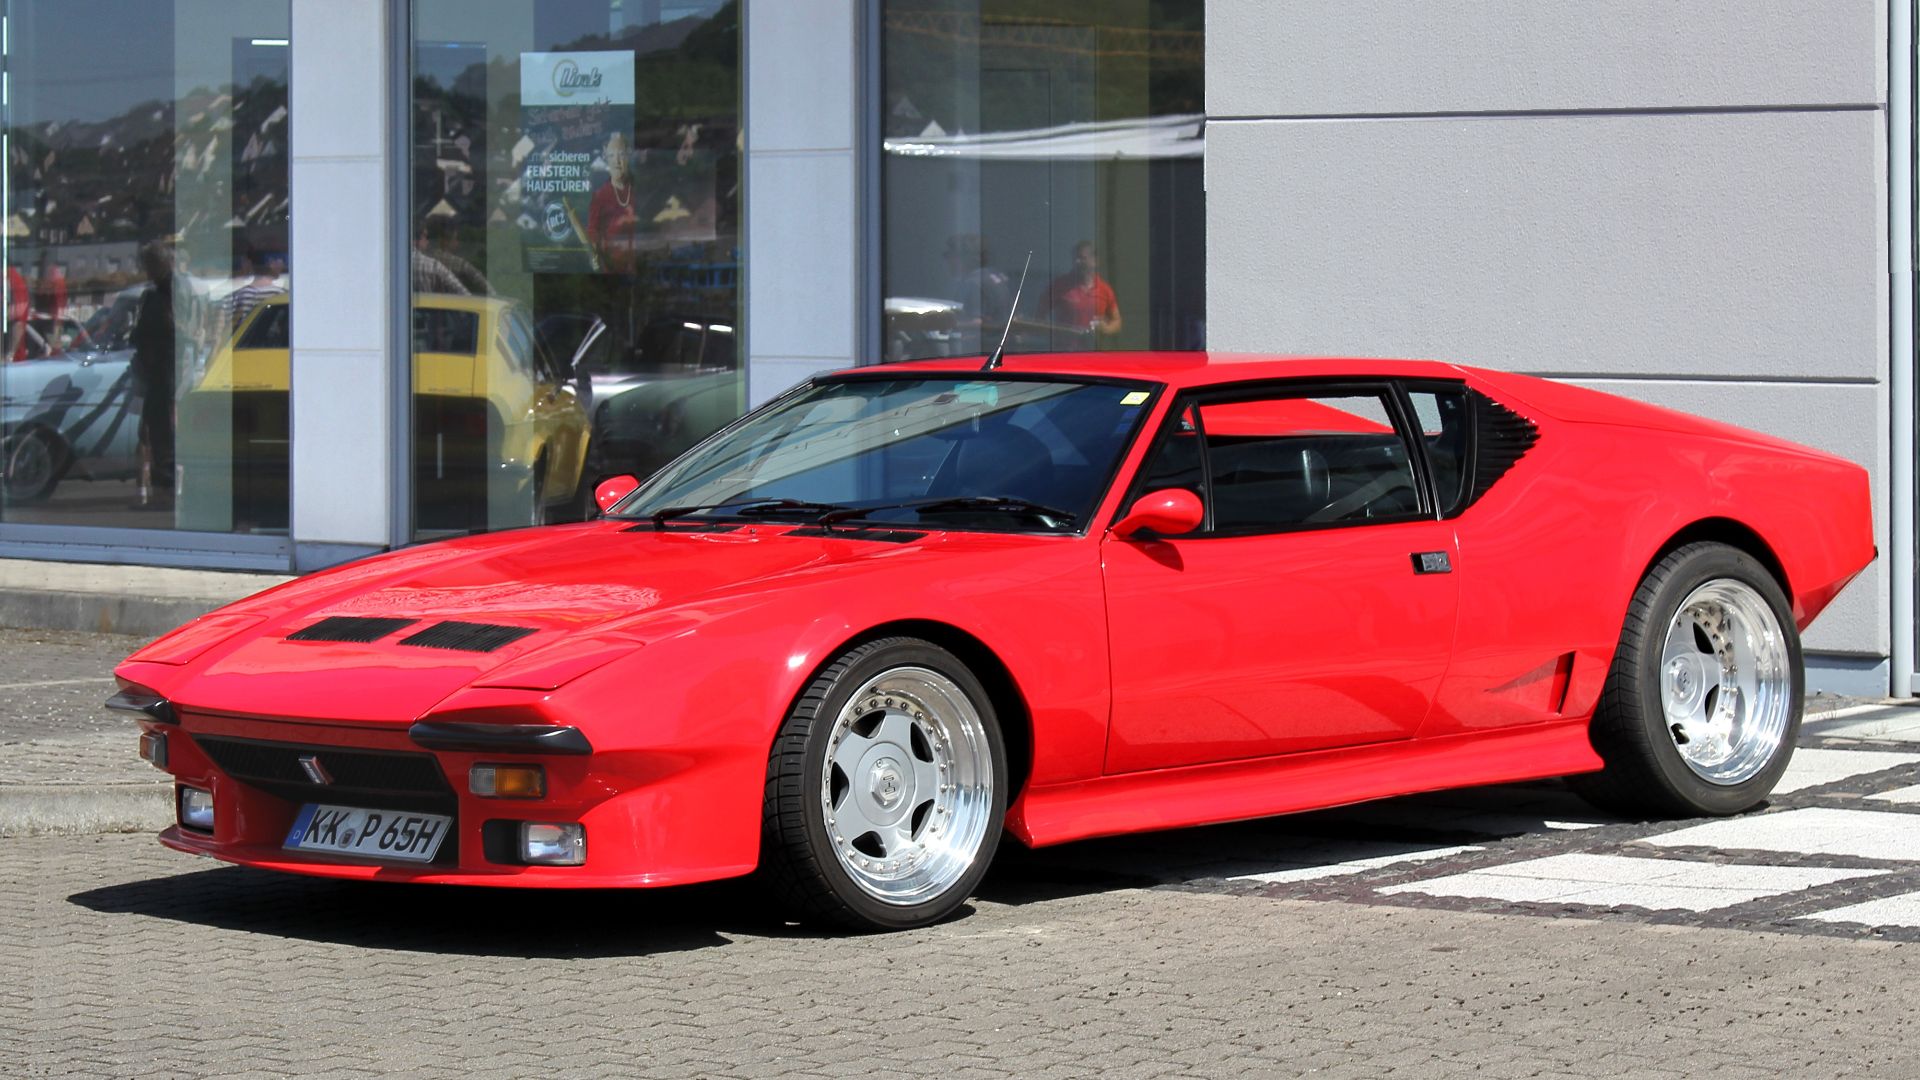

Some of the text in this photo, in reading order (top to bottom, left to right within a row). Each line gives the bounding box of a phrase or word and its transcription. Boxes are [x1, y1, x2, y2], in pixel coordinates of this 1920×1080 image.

[549, 150, 590, 162] sicheren
[526, 165, 580, 177] FENSTERN
[526, 178, 590, 192] HAUSTÜREN
[303, 810, 441, 854] KK P 65H
